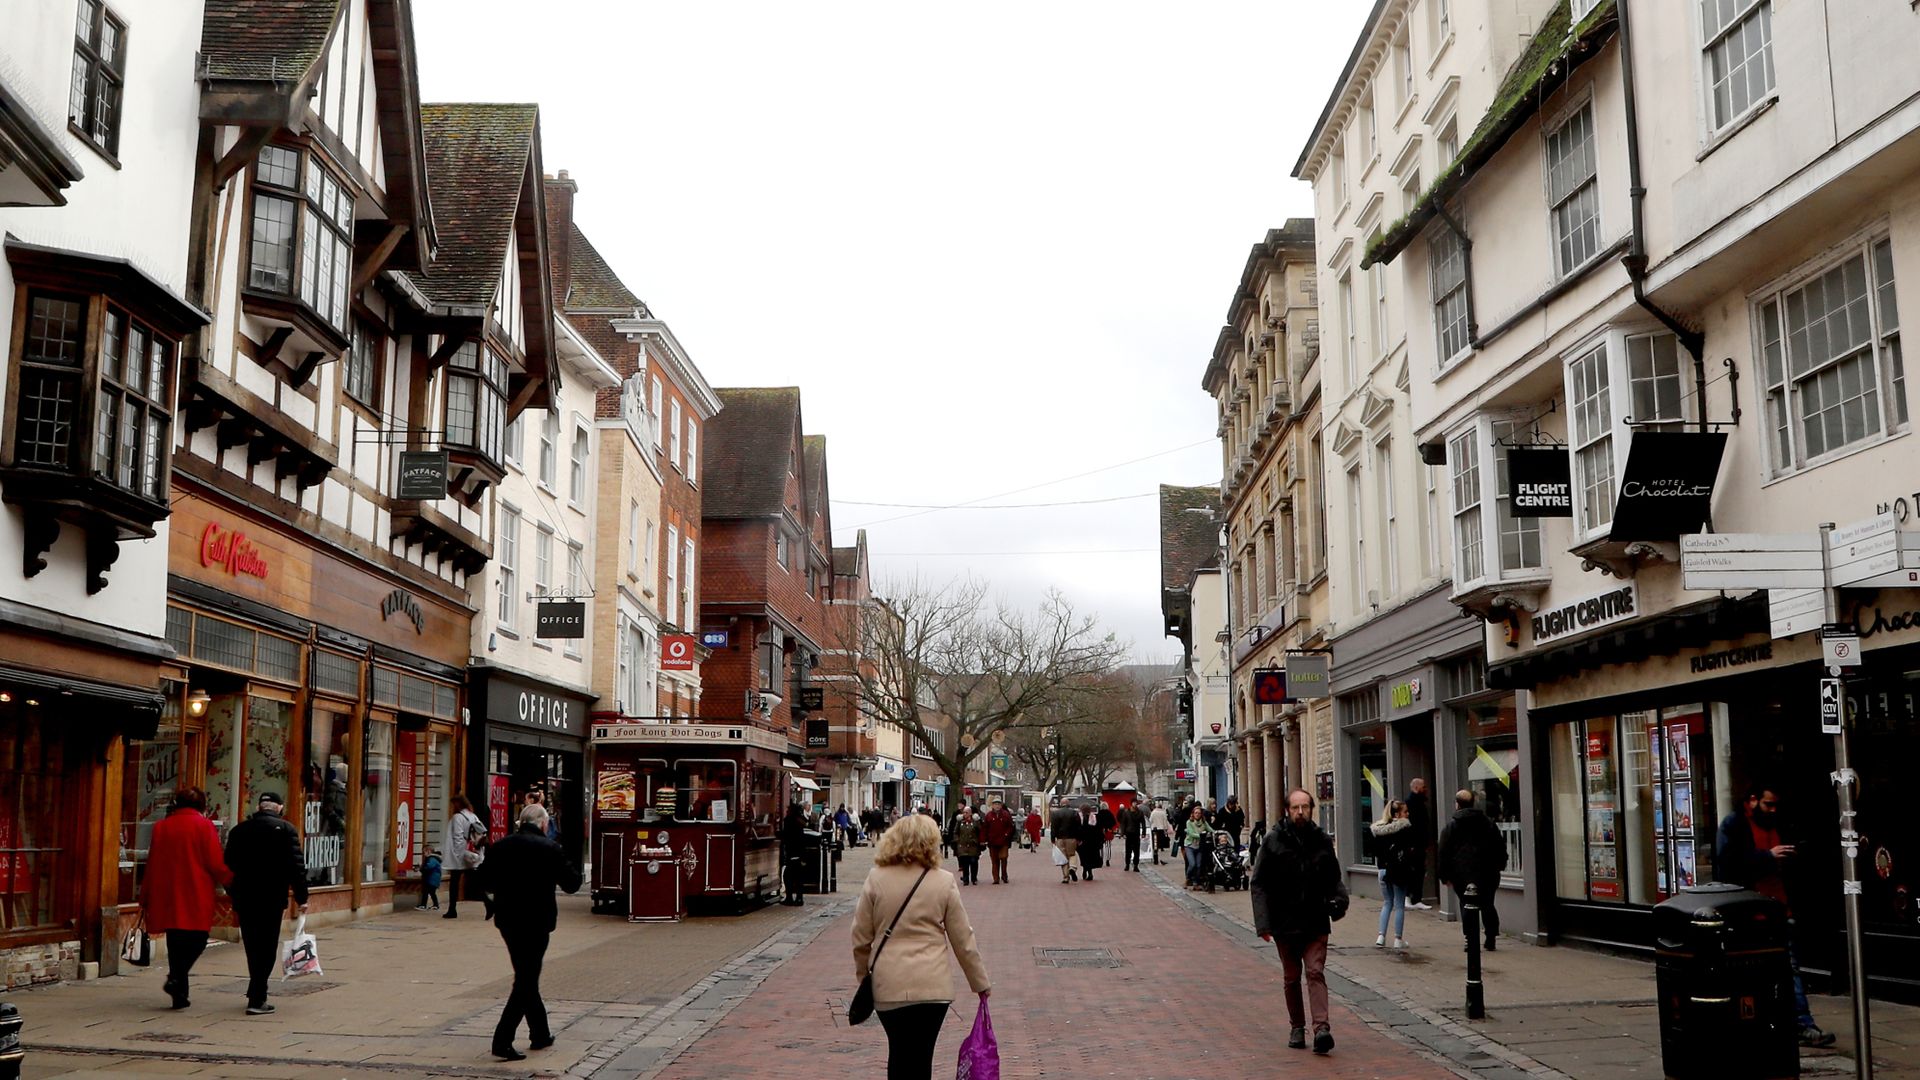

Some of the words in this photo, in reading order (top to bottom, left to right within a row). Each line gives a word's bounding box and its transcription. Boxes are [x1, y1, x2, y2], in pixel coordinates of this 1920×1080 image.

[404, 468, 441, 478] FATFACE
[1518, 484, 1567, 494] FLIGHT
[1651, 479, 1687, 487] HOTEL
[1515, 496, 1570, 506] CENTRE
[1685, 539, 1718, 548] Cathedral
[200, 521, 228, 568] Cath
[225, 529, 269, 579] Kidston
[1532, 605, 1576, 640] FLIGHT
[1577, 586, 1634, 626] CENTRE
[541, 616, 580, 624] OFFICE
[1690, 650, 1728, 673] FLIGHT
[1727, 641, 1773, 666] CENTRE
[1291, 671, 1324, 682] hotter
[519, 692, 568, 729] OFFICE
[1823, 703, 1837, 713] CCTV
[614, 728, 637, 738] Foot
[641, 728, 666, 738] Long
[670, 727, 690, 737] Hot
[694, 728, 722, 739] Dogs
[146, 749, 179, 794] SALE
[1588, 764, 1602, 776] SALE
[305, 801, 321, 834] GET
[304, 834, 340, 870] LAYERED
